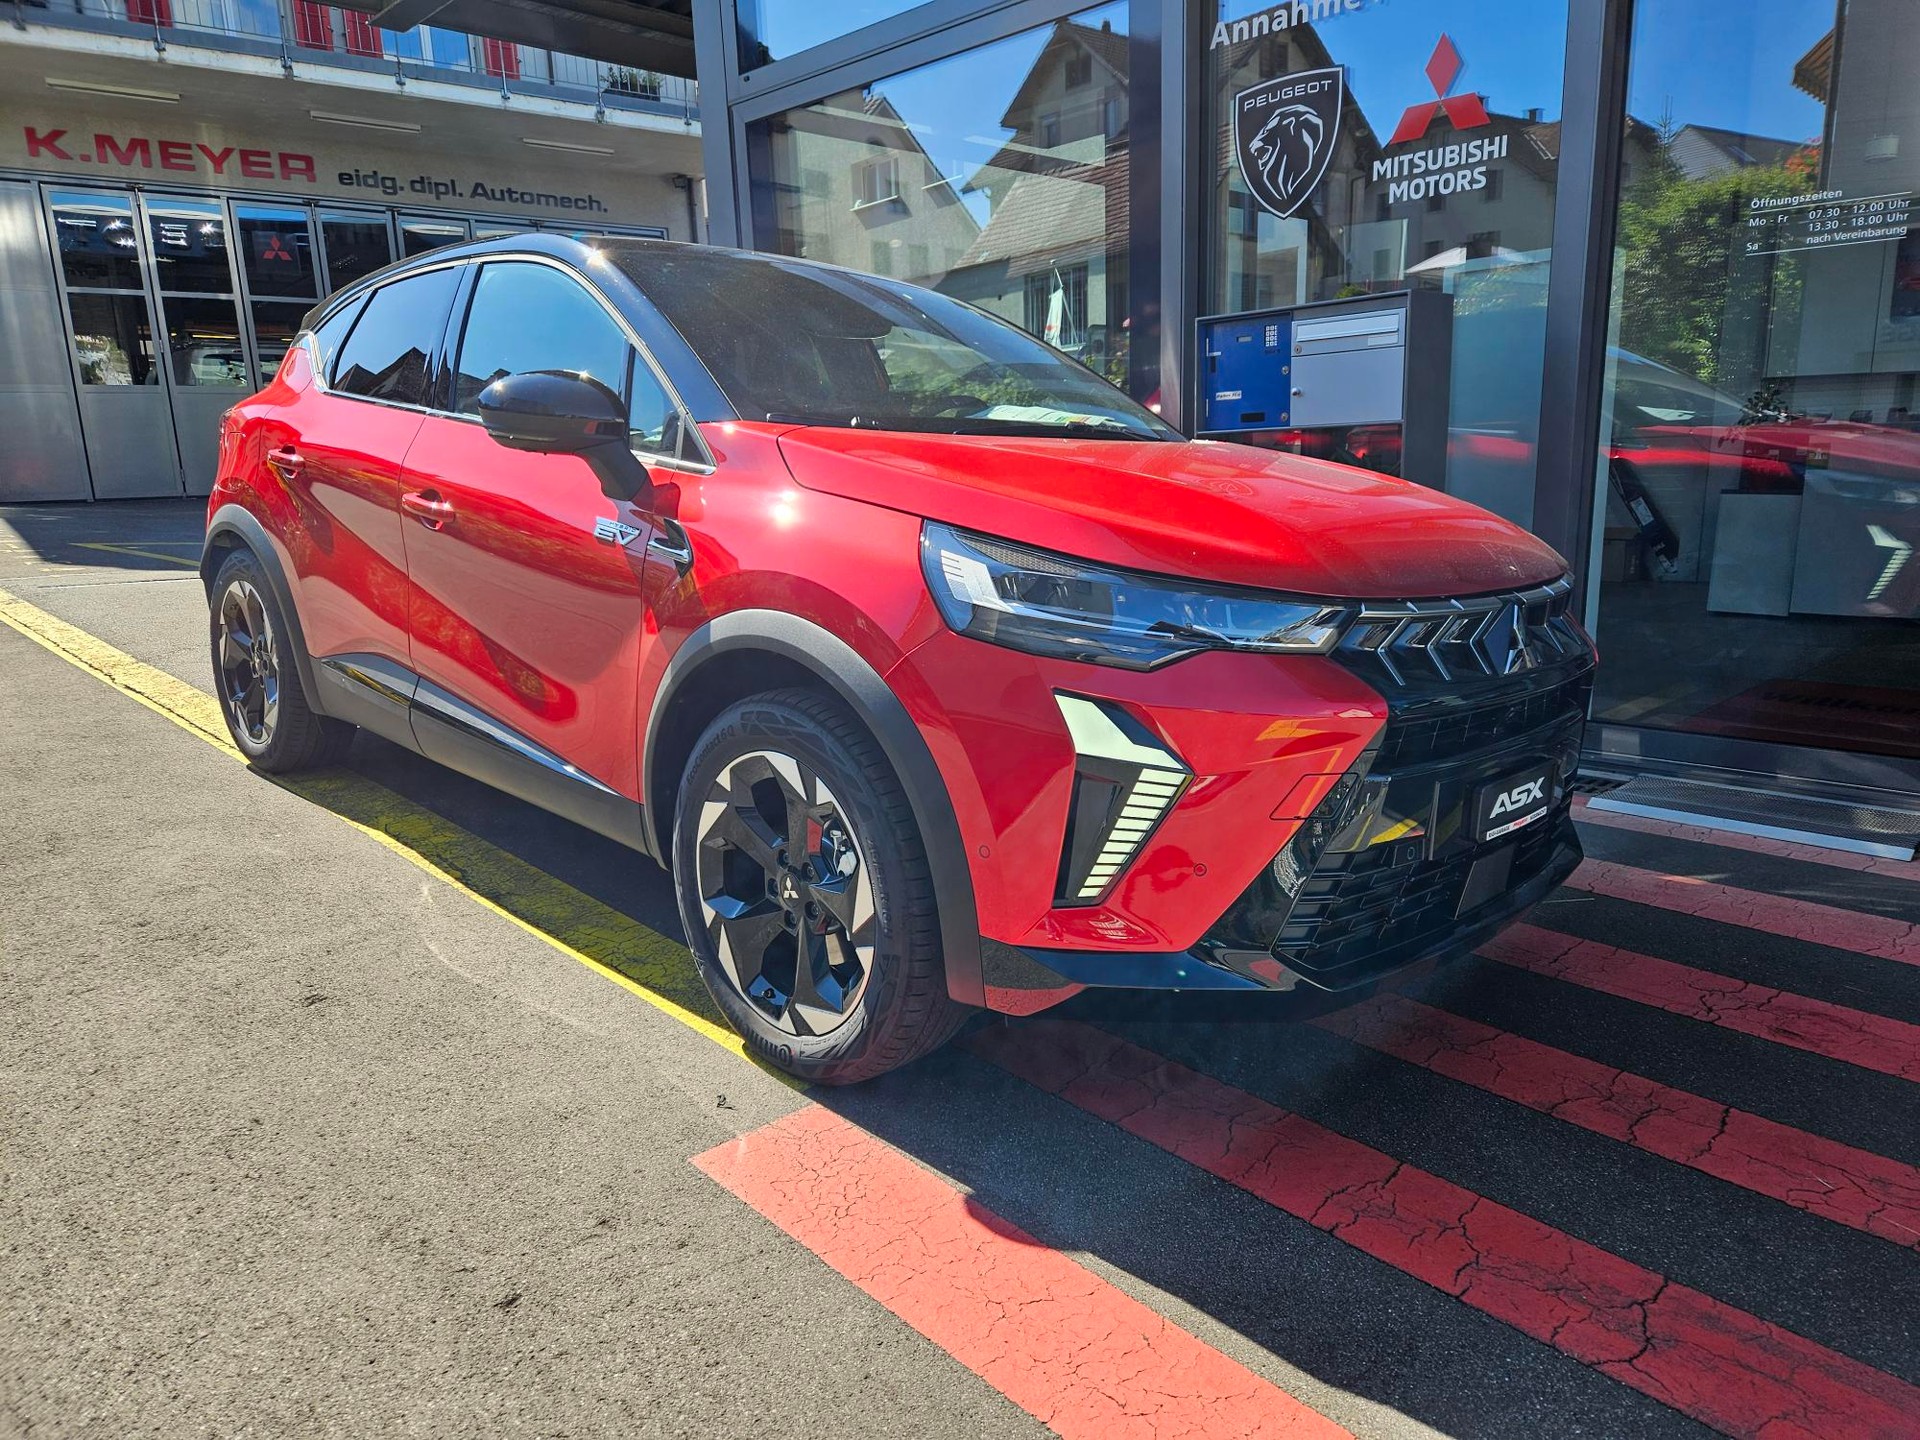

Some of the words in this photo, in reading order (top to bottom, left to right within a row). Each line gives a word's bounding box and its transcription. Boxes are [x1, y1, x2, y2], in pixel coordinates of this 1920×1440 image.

[1244, 80, 1332, 112] PEUGEOT
[23, 126, 317, 183] K.MEYER
[1372, 134, 1508, 182] MITSUBISHI
[338, 168, 404, 196] eidg.
[410, 175, 463, 200] dipl.
[470, 182, 608, 213] Automech.
[1388, 166, 1487, 204] MOTORS
[1751, 189, 1843, 209] Öffnungszeiten
[1750, 217, 1767, 227] Mo
[1777, 214, 1789, 224] Fr
[1809, 207, 1840, 219] 07.30
[1853, 202, 1884, 214] 12.00
[1889, 199, 1911, 210] Uhr
[1808, 220, 1839, 232] 13.30
[1851, 214, 1883, 226] 18.00
[1887, 211, 1909, 223] Uhr
[1746, 242, 1759, 251] Sa
[1806, 234, 1831, 245] nach
[1834, 225, 1907, 241] Vereinbarung
[1489, 776, 1545, 819] ASX
